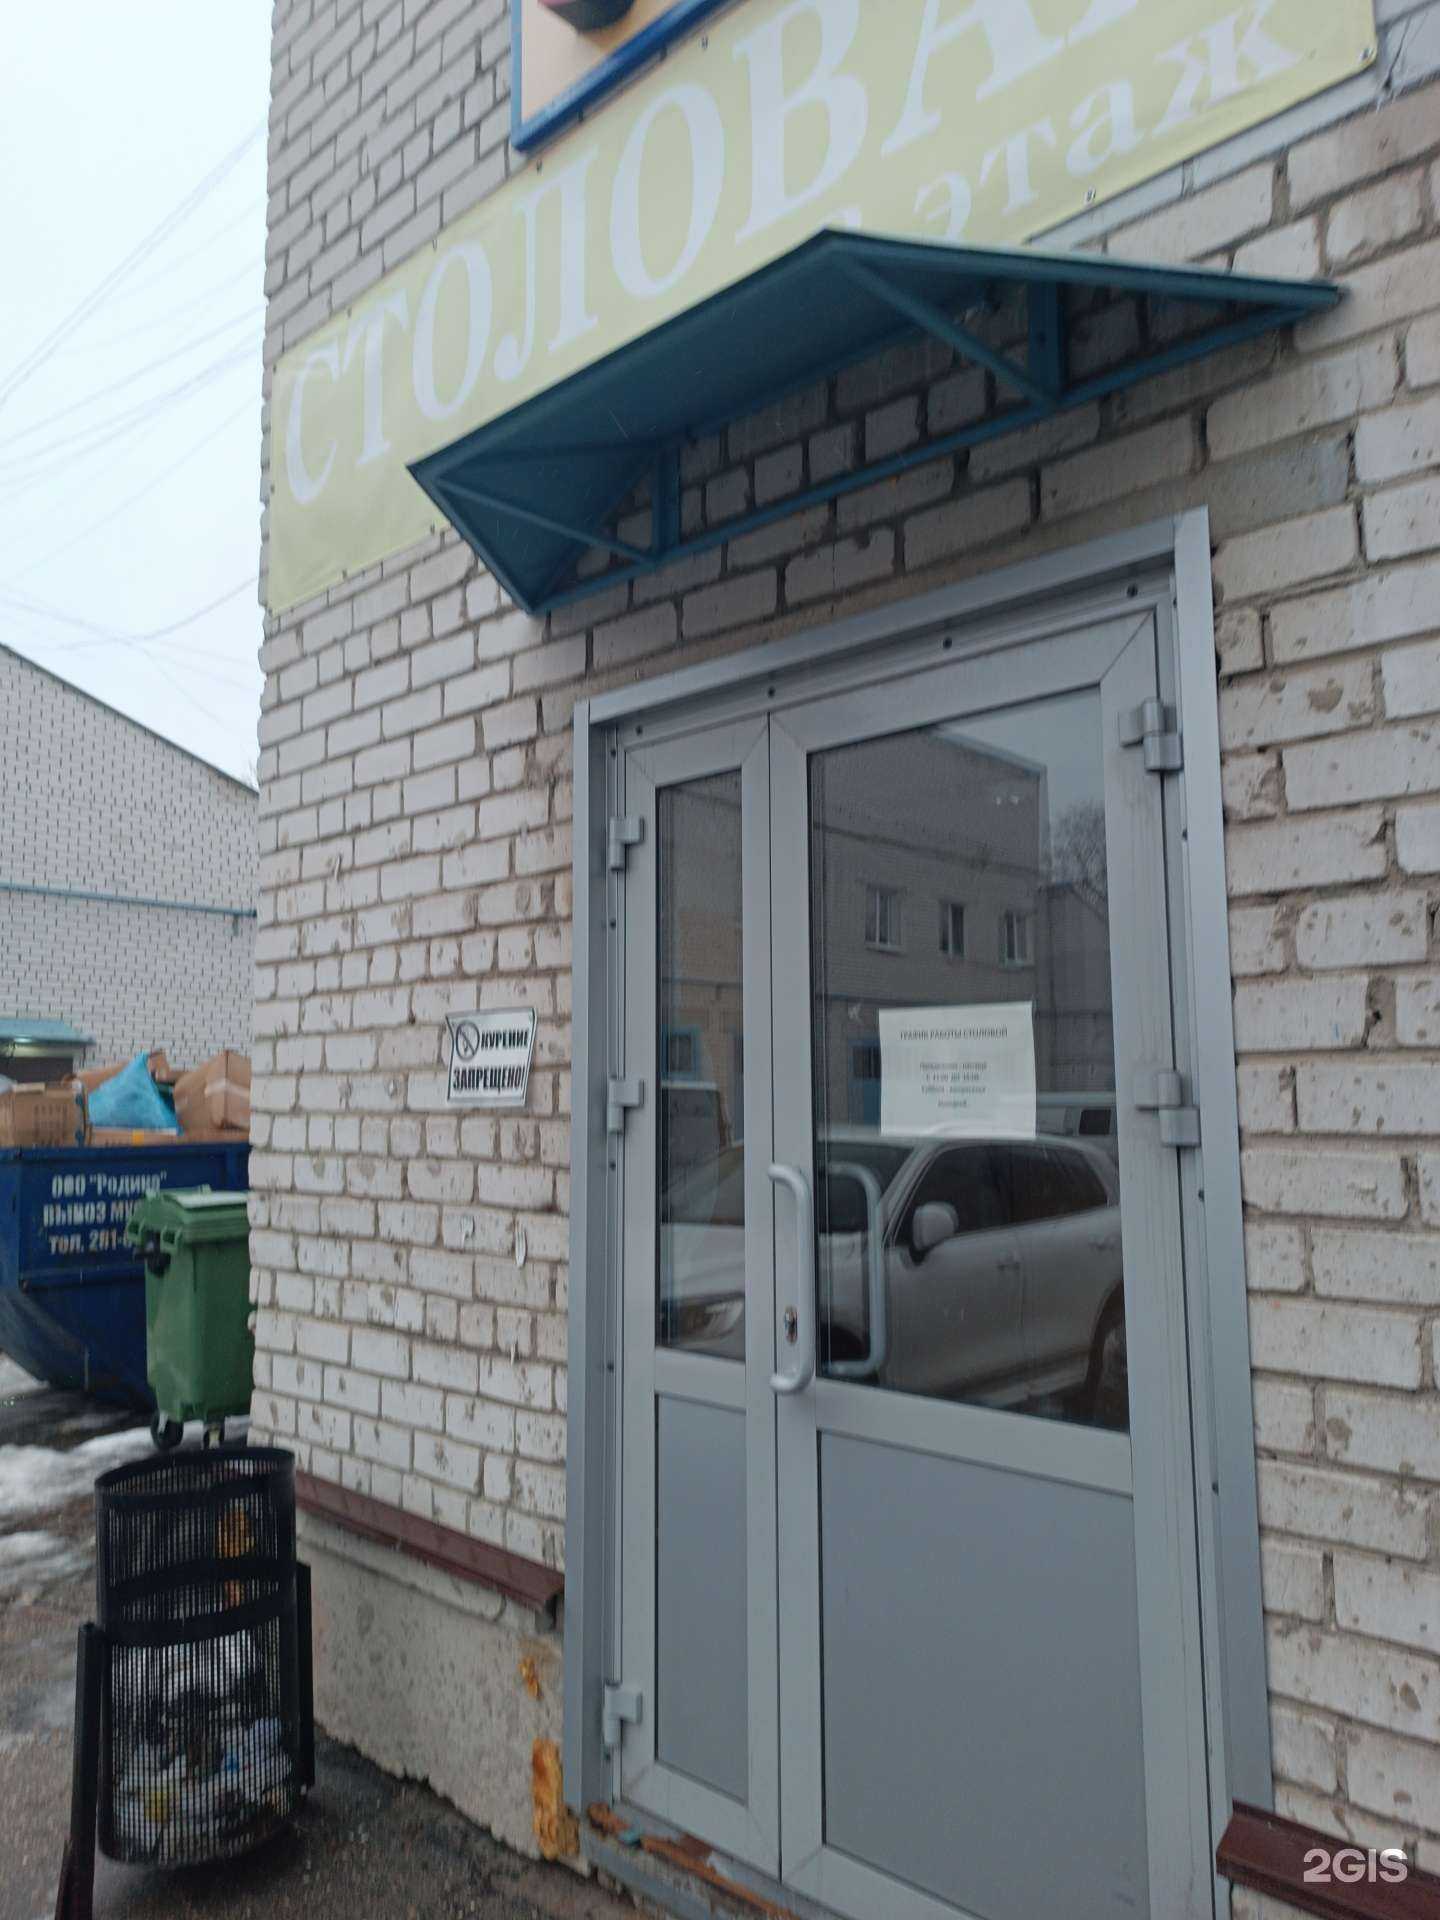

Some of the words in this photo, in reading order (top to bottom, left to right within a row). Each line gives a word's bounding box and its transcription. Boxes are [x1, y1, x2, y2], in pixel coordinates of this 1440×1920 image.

[285, 0, 1136, 504] СТОЛОВА
[480, 1029, 529, 1049] КУРЕНИЕ
[52, 1174, 86, 1198] ООО
[43, 1201, 106, 1226] ВЫВОЗ
